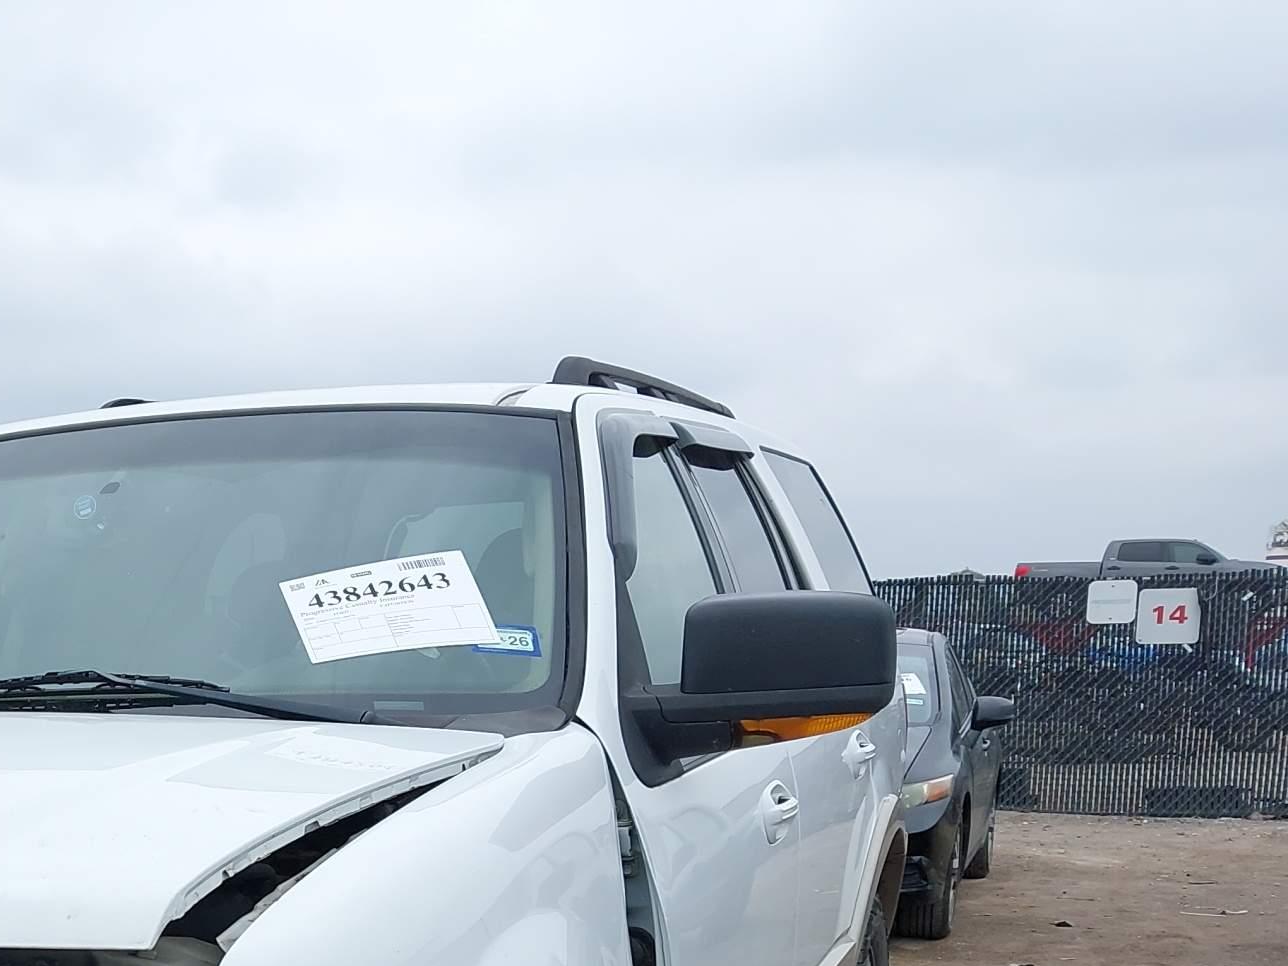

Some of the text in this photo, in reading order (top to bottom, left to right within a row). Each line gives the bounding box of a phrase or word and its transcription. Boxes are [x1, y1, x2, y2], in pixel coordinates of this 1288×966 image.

[308, 572, 451, 608] 43842643
[1152, 605, 1188, 625] 14
[508, 635, 529, 647] 26
